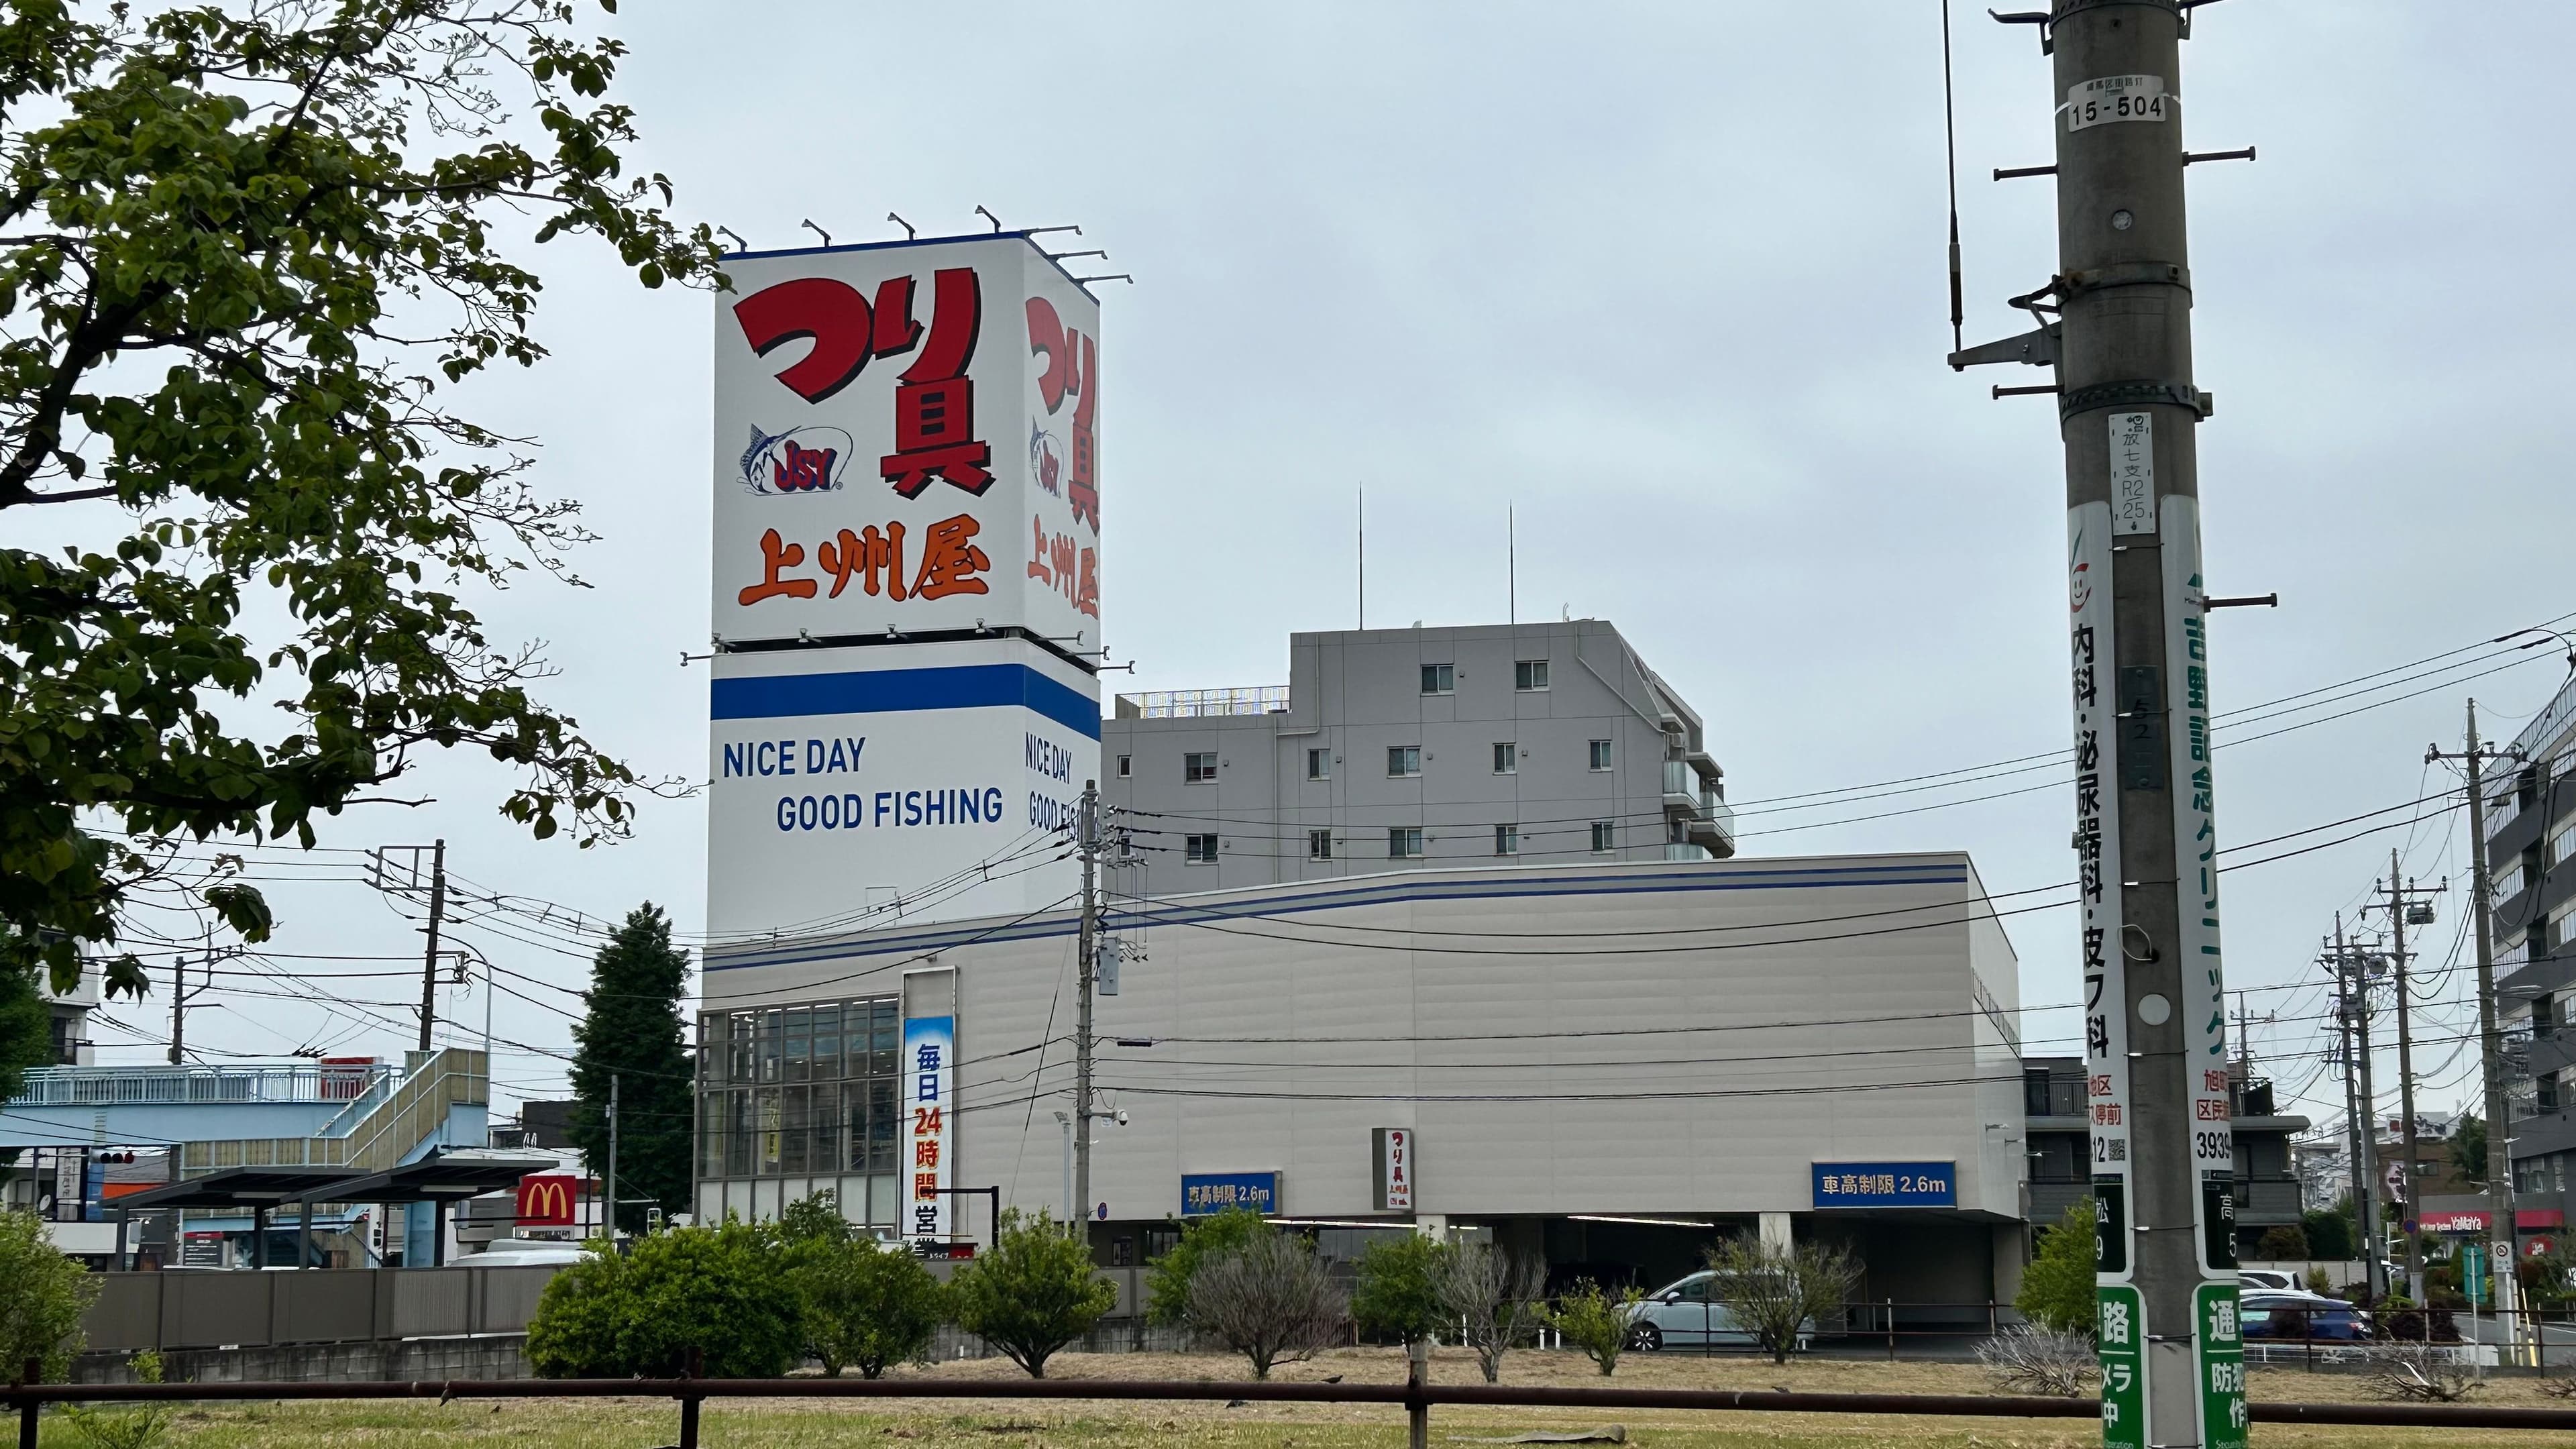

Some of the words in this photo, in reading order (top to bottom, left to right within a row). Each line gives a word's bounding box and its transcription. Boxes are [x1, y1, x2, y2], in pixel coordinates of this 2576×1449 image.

[2073, 96, 2161, 125] 15-504
[773, 440, 838, 492] JSY
[739, 514, 991, 606] 上州屋
[724, 741, 796, 777] NICE
[807, 737, 865, 775] DAY
[1026, 732, 1050, 775] NICE
[1053, 748, 1072, 784] DAY
[777, 794, 863, 832] GOOD
[875, 787, 1003, 828] FISHING
[1030, 790, 1057, 833] GOOD
[1238, 1185, 1270, 1202] 2.6m
[1822, 1174, 1895, 1195] 車高制限
[1900, 1175, 1946, 1193] 2.6m
[2103, 1301, 2129, 1344] 路
[2208, 1299, 2237, 1342] 通
